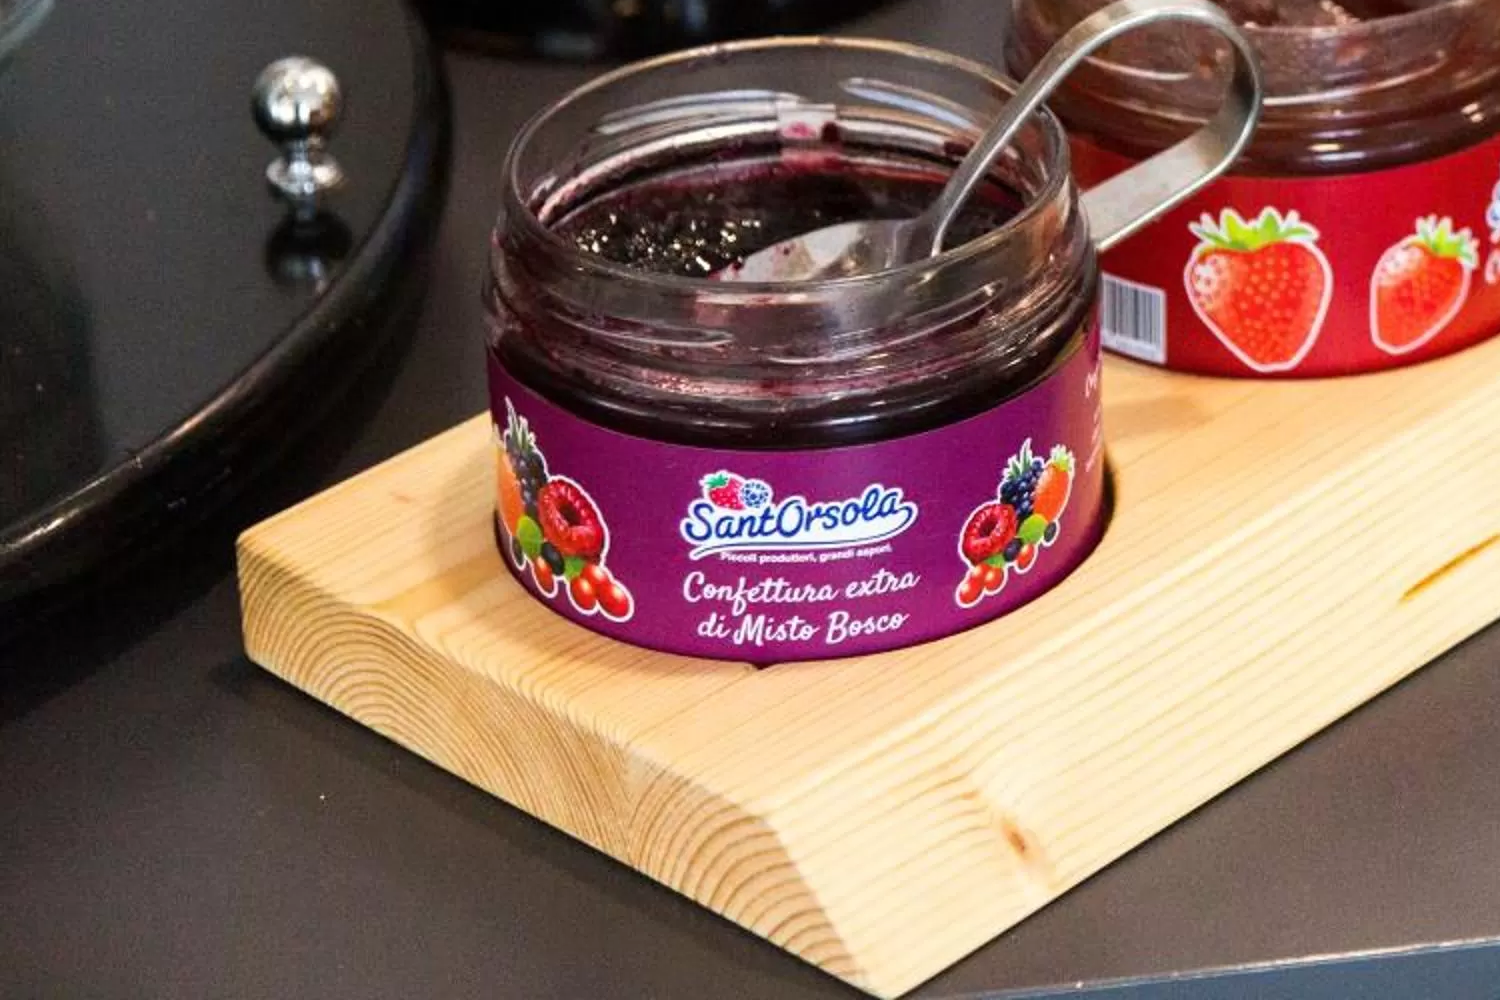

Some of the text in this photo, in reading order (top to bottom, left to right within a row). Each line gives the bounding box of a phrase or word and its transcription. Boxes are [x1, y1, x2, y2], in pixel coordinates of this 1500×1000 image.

[683, 567, 921, 616] Confettura extra
[697, 611, 911, 647] di Misto Bosco
